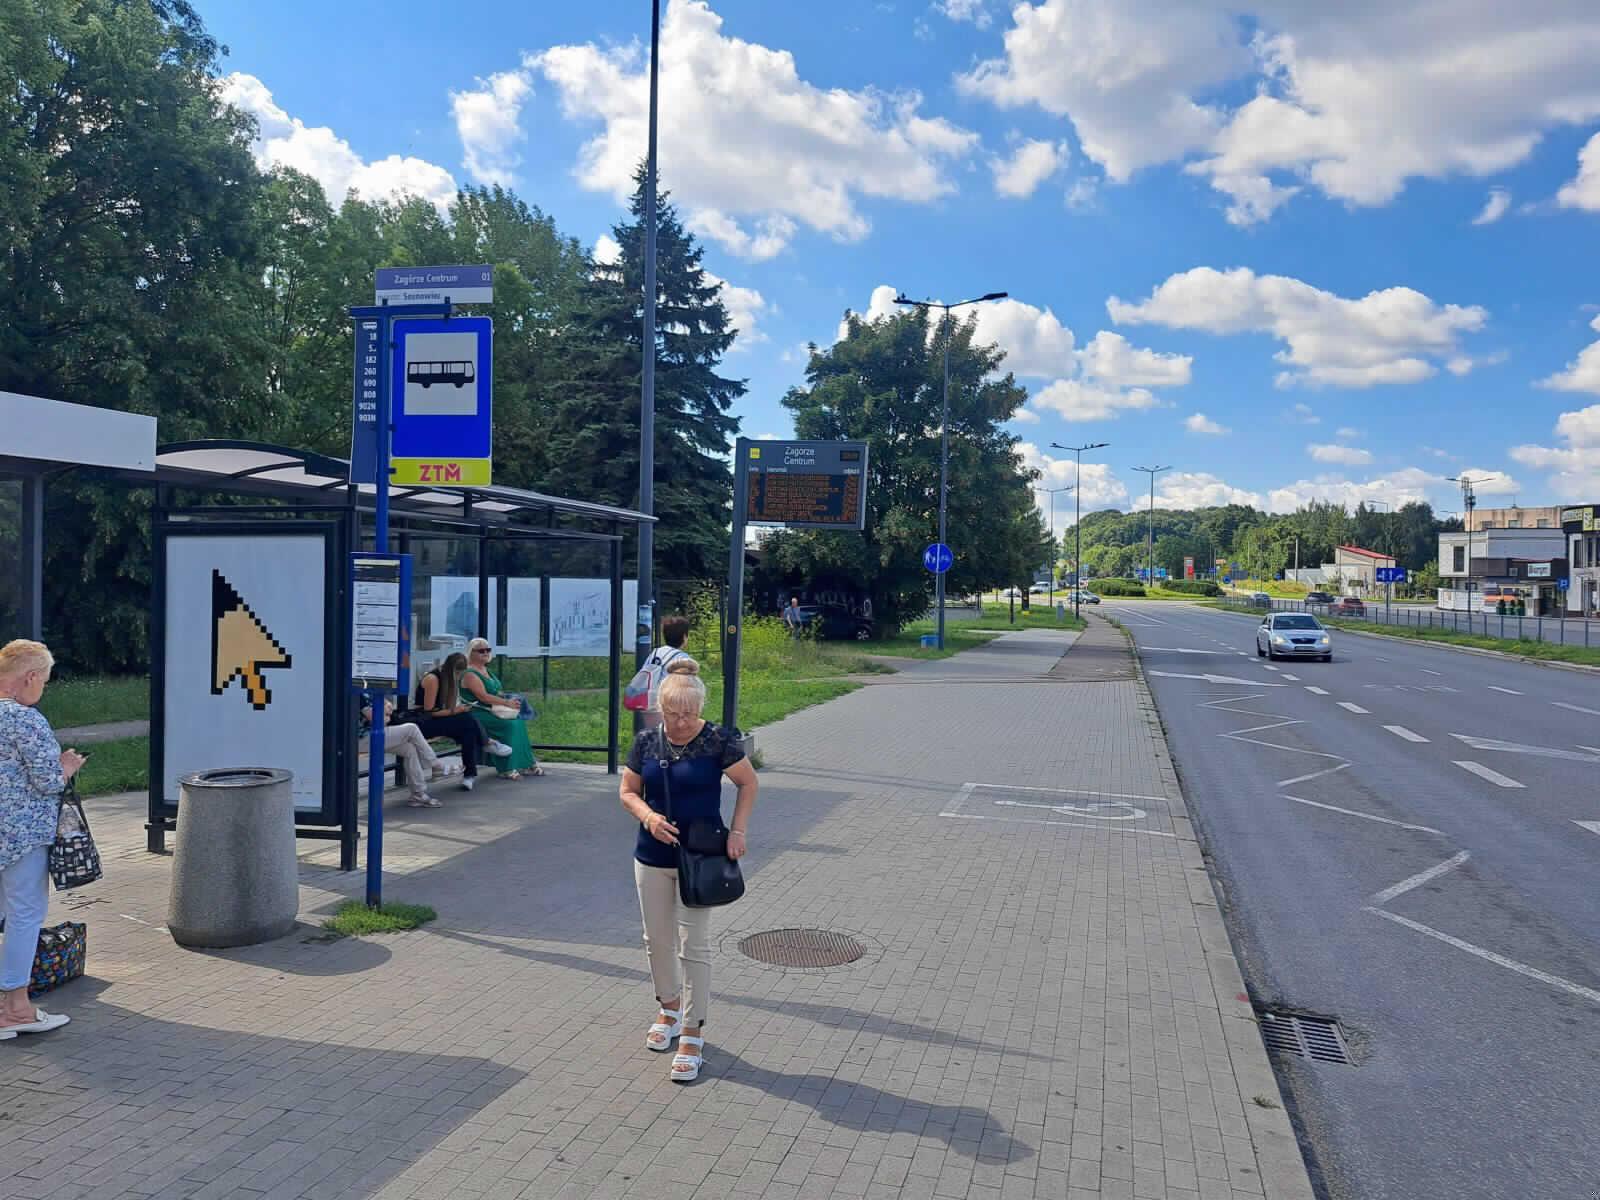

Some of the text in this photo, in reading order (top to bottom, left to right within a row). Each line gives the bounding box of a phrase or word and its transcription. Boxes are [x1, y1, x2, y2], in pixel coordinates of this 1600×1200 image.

[426, 273, 458, 283] Centrum
[481, 272, 491, 281] 01
[784, 455, 815, 465] Centrum
[419, 463, 461, 481] ZTM
